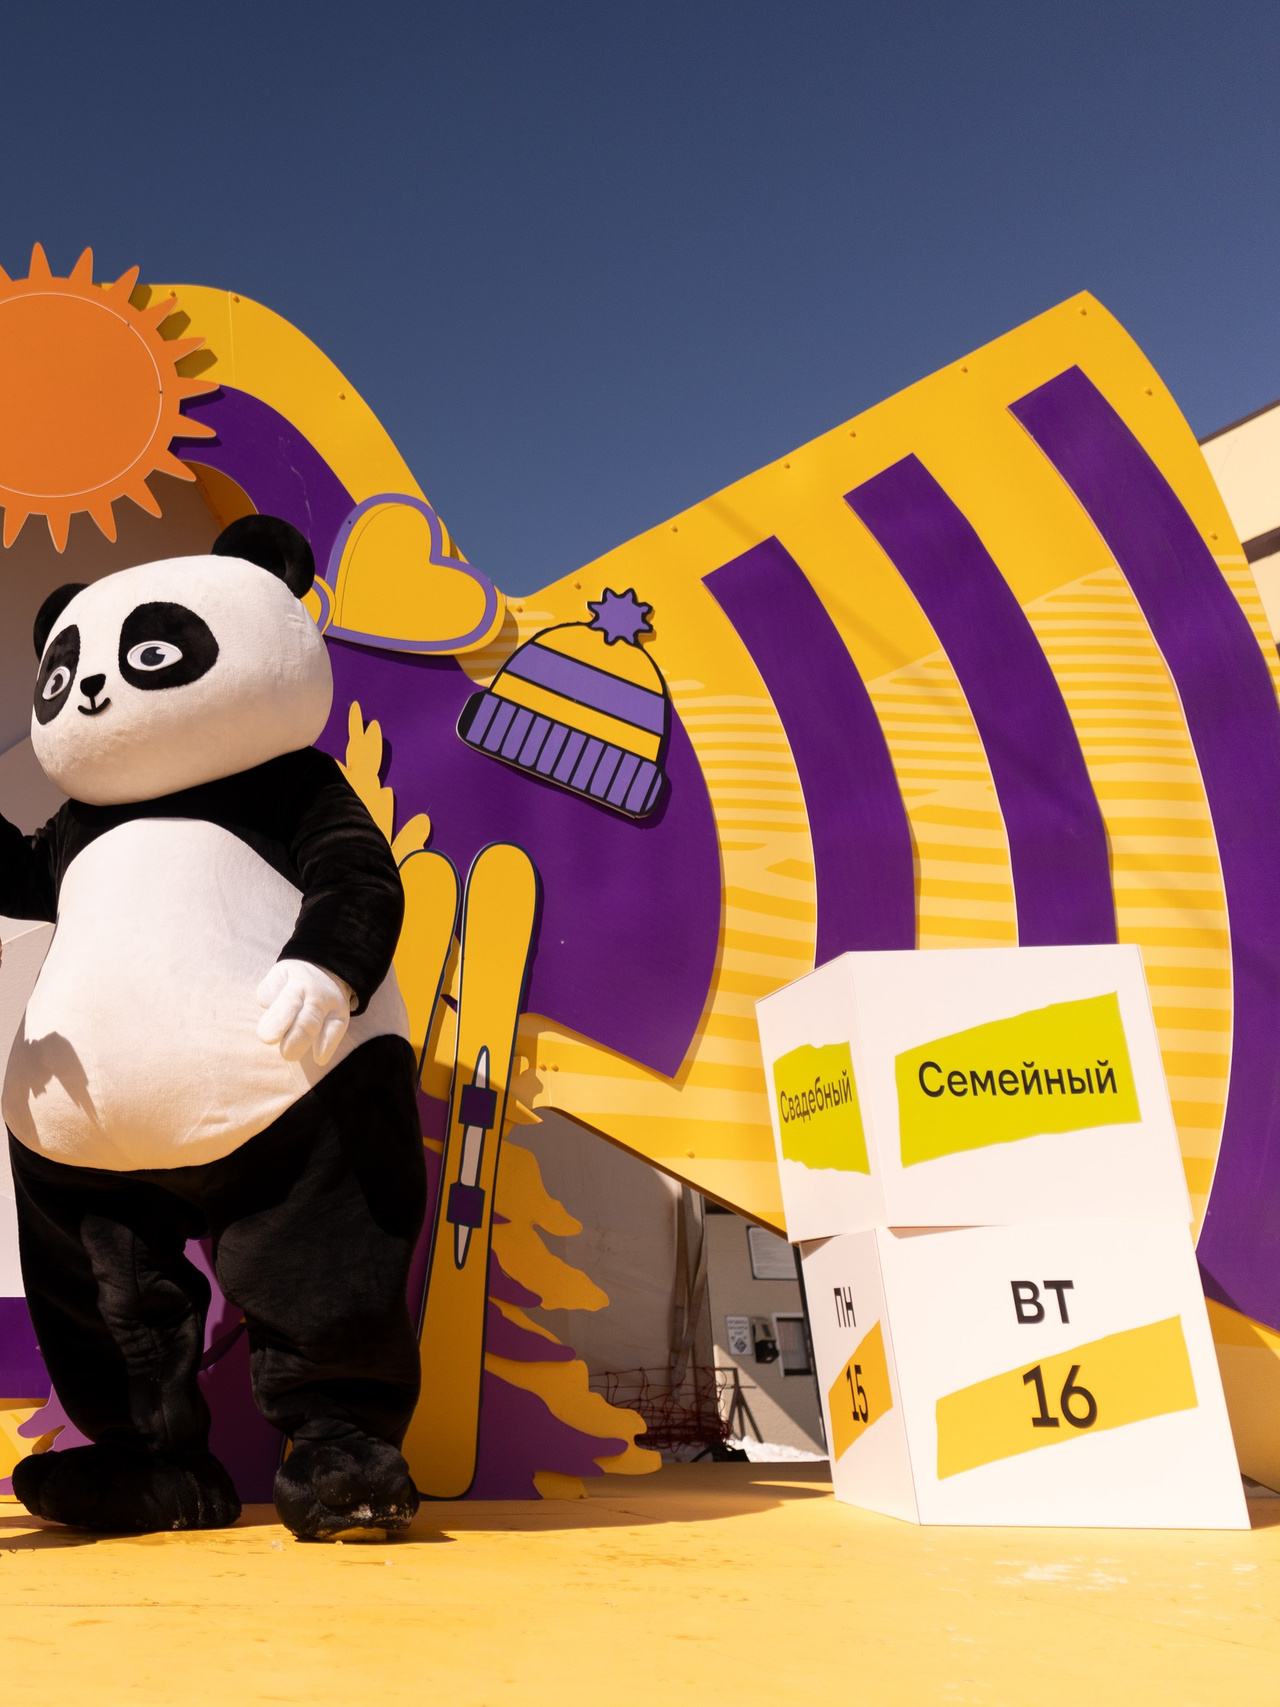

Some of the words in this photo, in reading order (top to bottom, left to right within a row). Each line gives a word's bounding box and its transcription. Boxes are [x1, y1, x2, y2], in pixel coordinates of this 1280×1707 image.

[780, 1069, 853, 1123] Свадебный
[918, 1059, 1118, 1098] Семейный
[833, 1286, 857, 1328] ПН
[1010, 1279, 1075, 1324] ВТ
[846, 1364, 869, 1424] 15
[1022, 1364, 1098, 1429] 16
